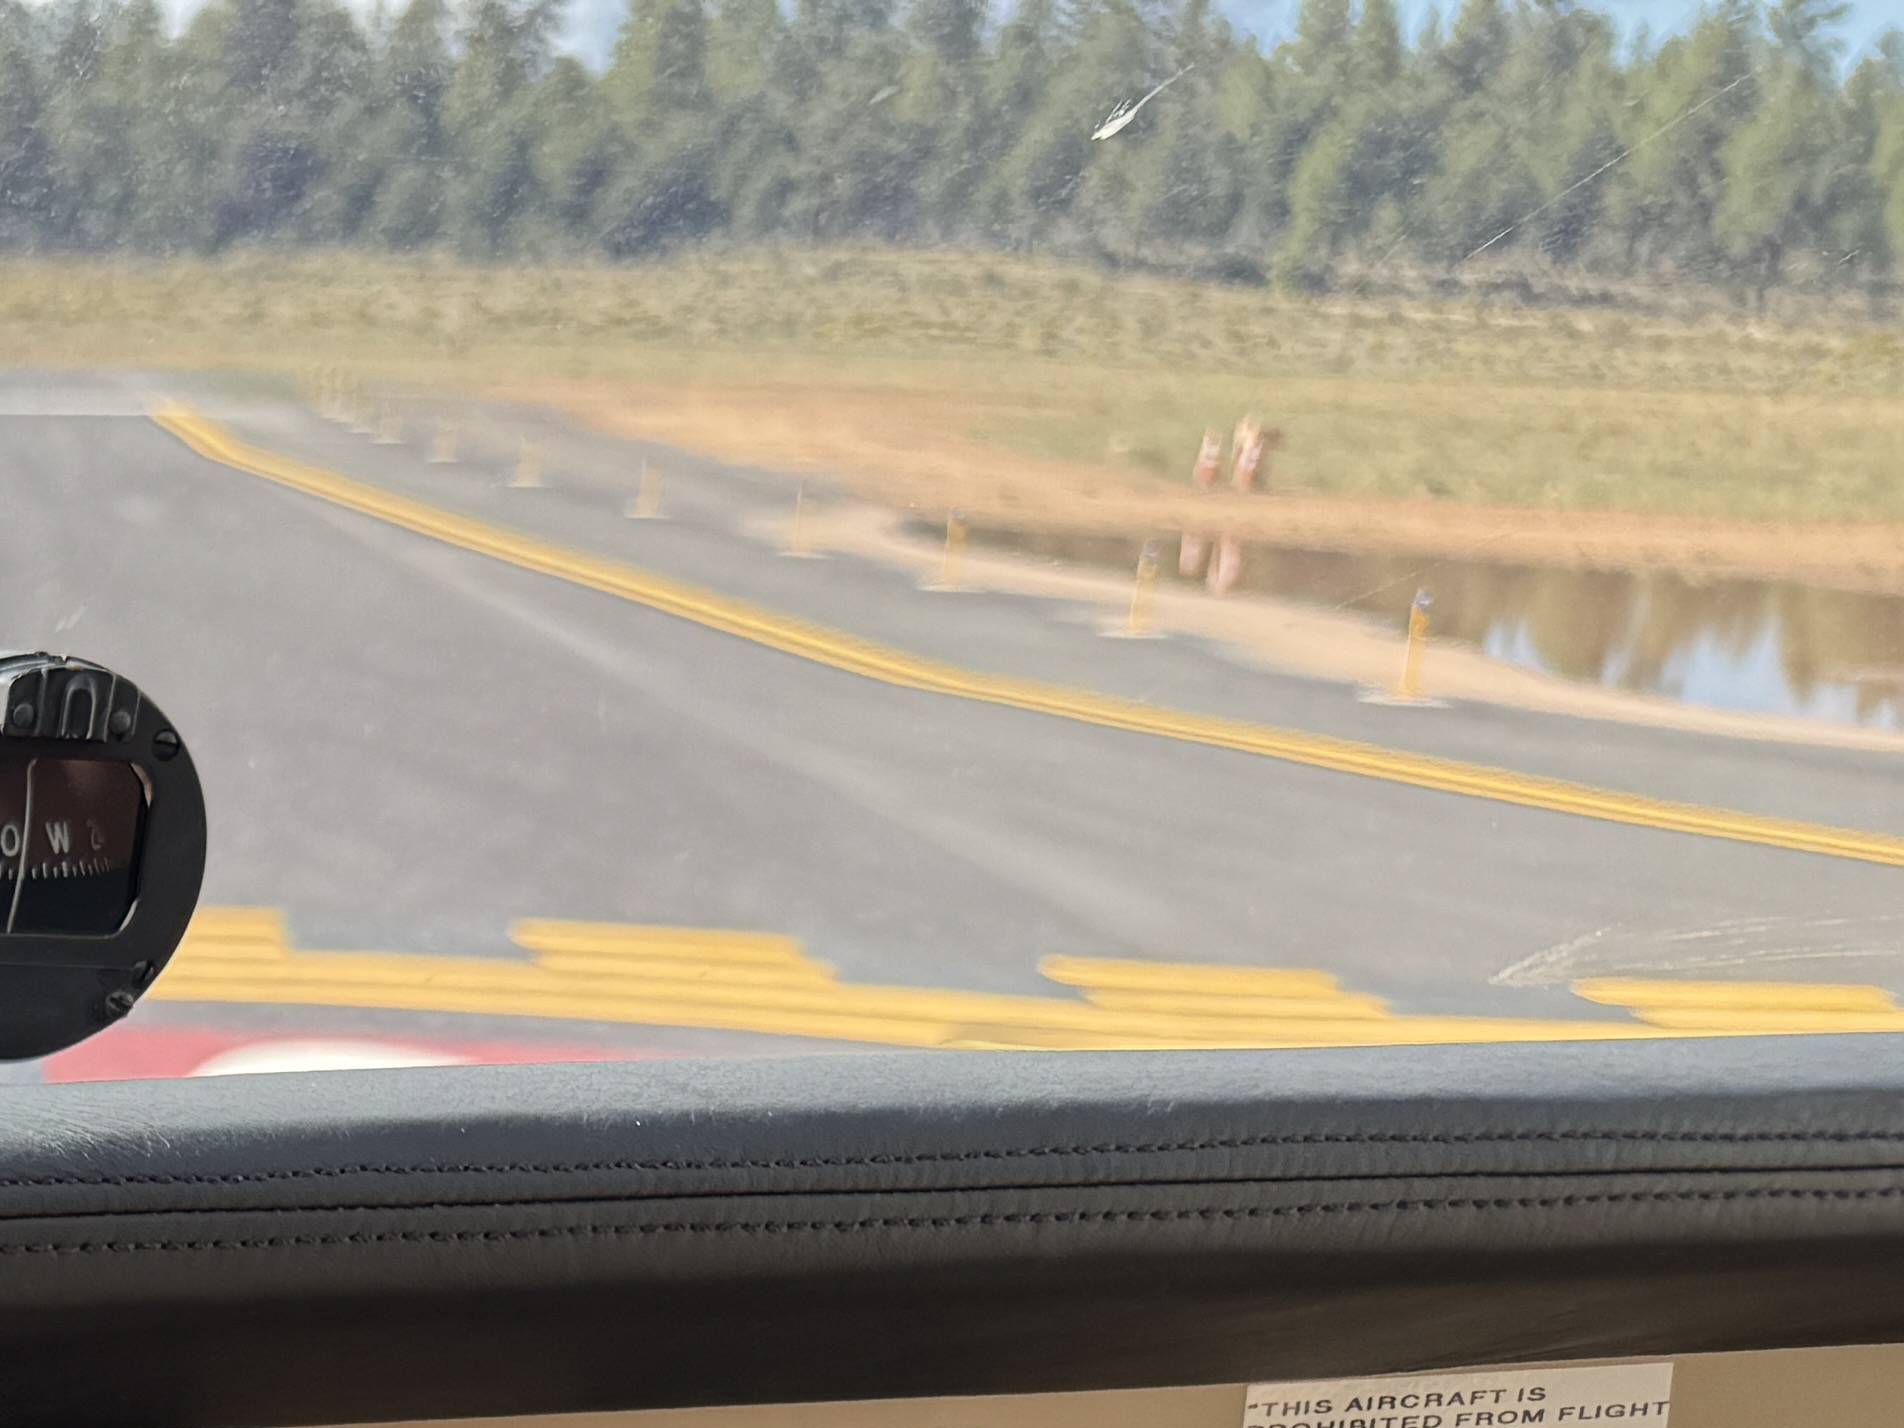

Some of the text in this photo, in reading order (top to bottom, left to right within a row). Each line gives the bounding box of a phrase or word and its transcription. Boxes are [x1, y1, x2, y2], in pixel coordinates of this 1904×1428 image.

[46, 821, 71, 854] W
[1344, 1388, 1508, 1412] AIRCRAFT
[1518, 1387, 1547, 1402] IS
[1454, 1409, 1546, 1427] FROM
[1558, 1401, 1671, 1421] FLIGHT
